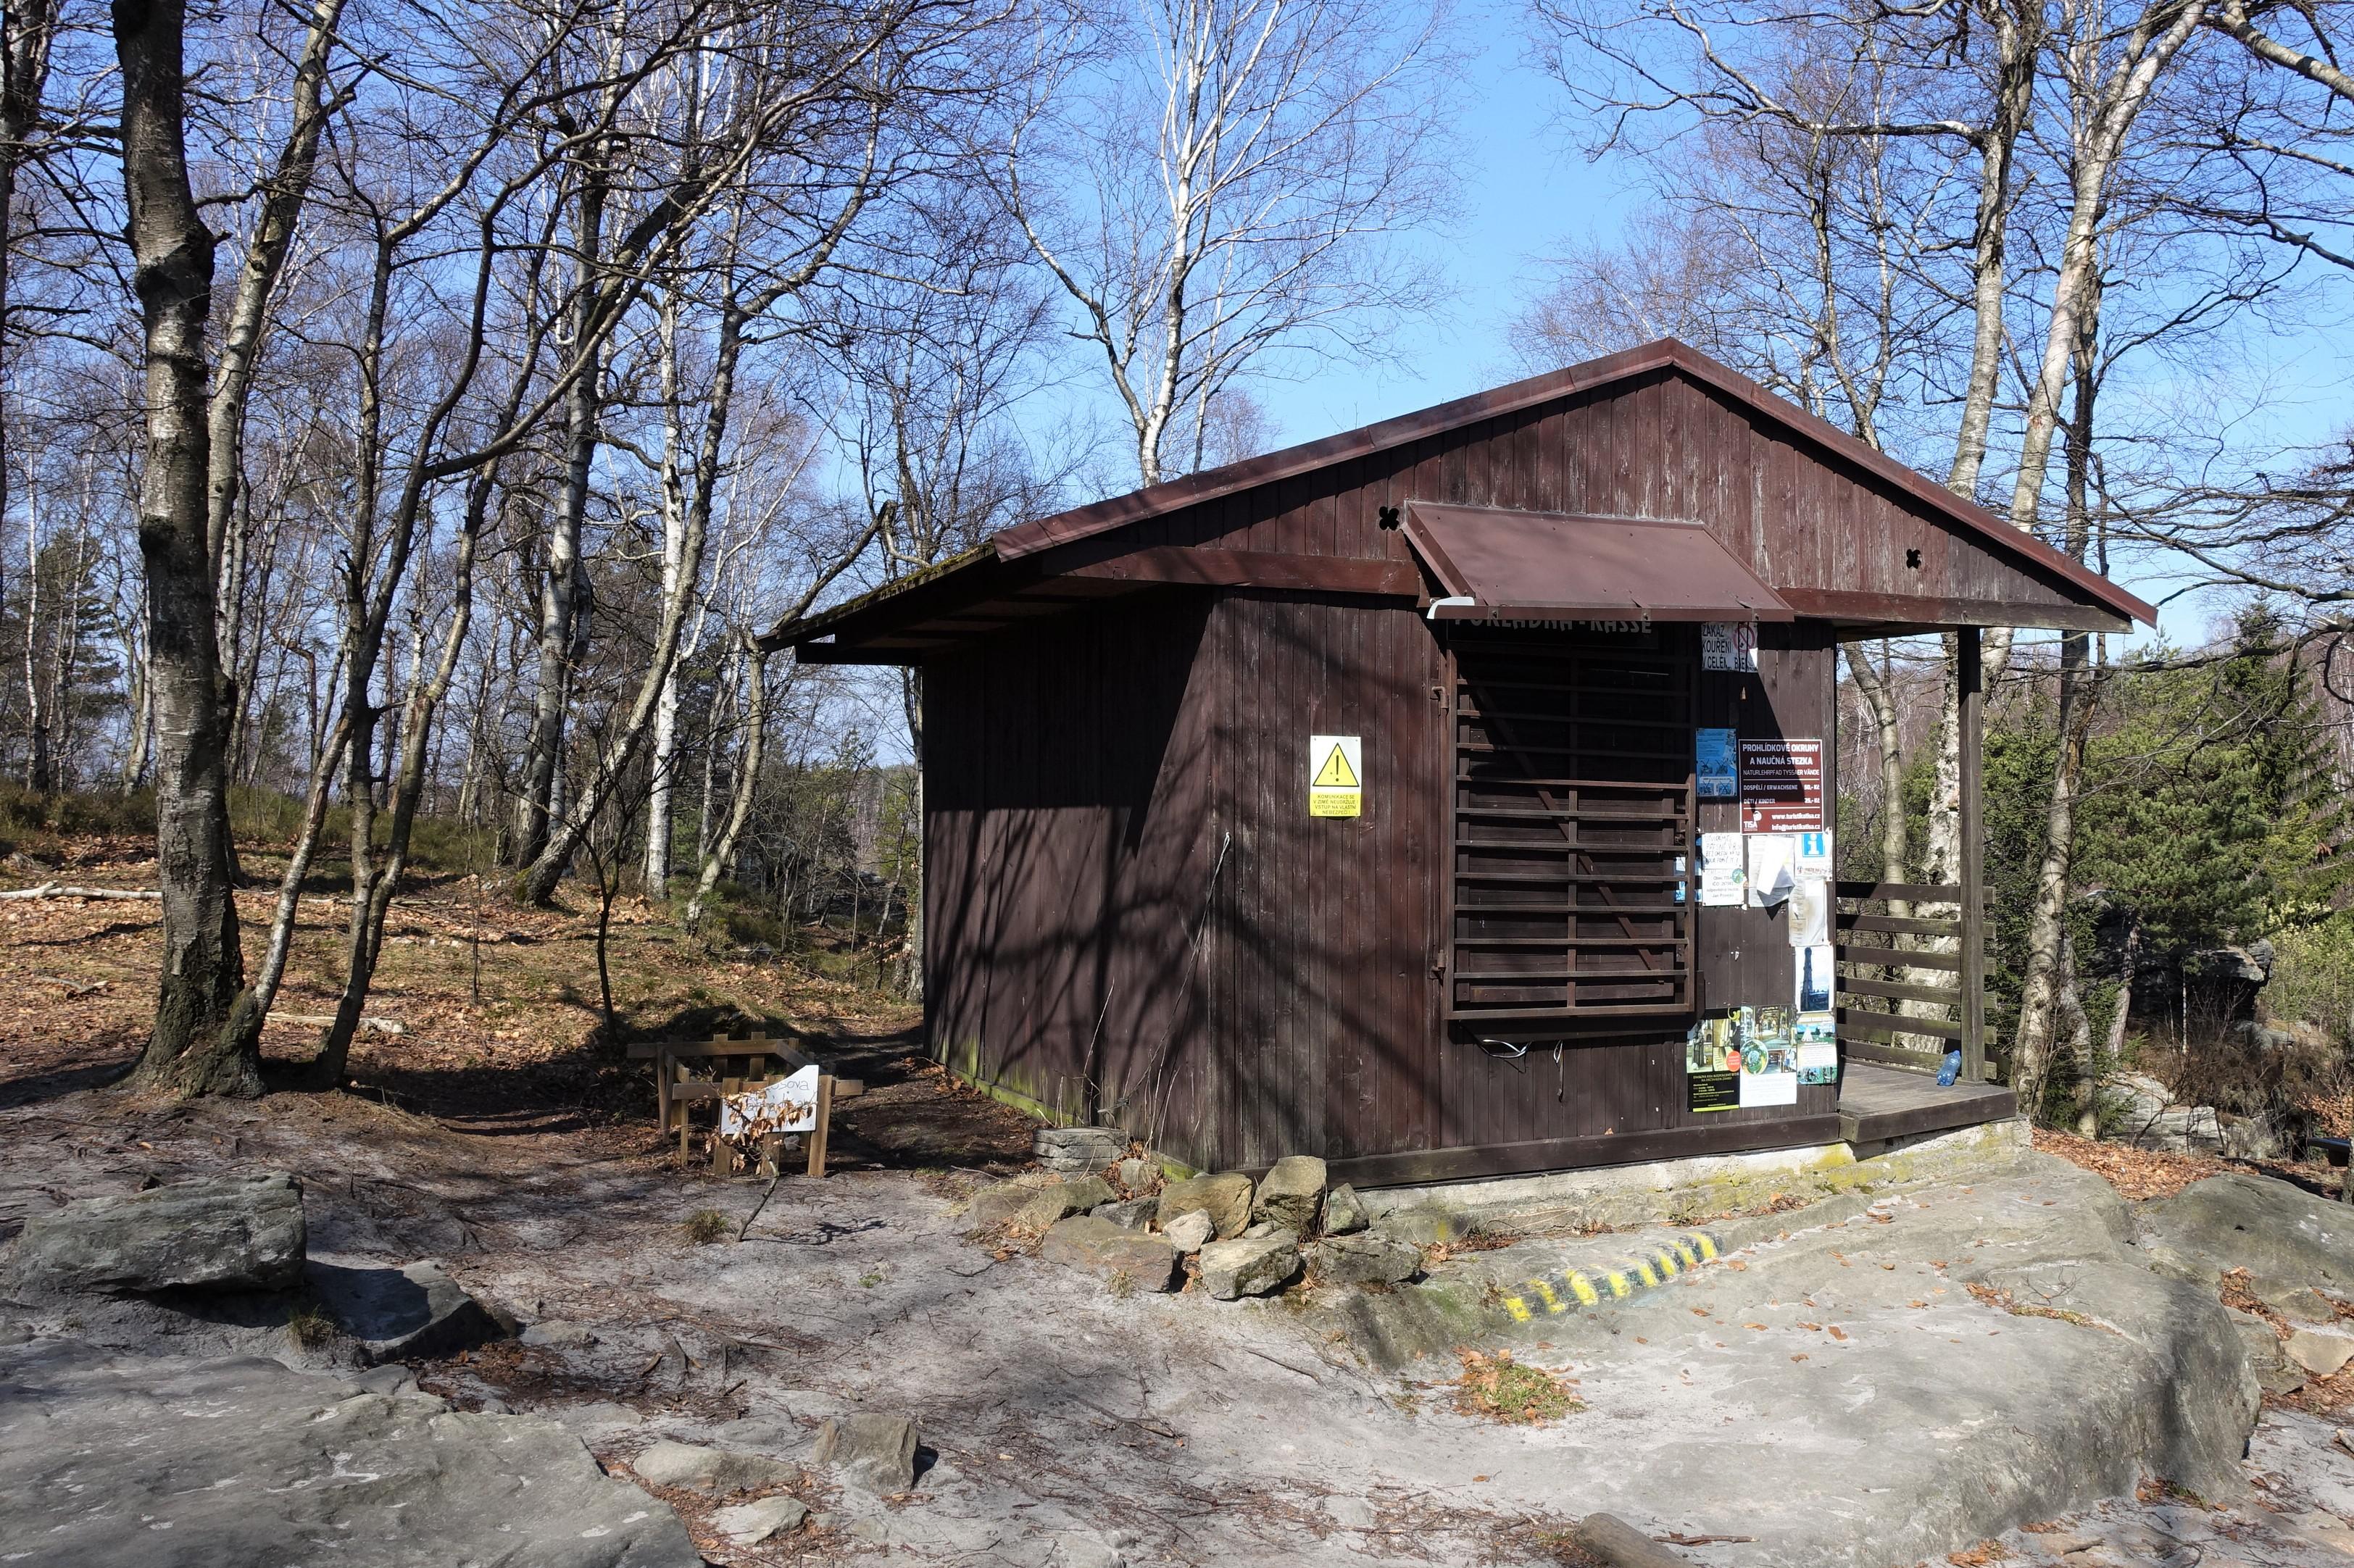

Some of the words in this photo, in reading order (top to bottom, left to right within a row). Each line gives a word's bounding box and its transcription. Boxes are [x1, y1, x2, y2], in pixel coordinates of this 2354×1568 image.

[1742, 742, 1790, 751] PROHLÍDKOVÉ
[1791, 743, 1819, 752] OKRUHY
[1756, 755, 1785, 764] NAUČNÁ
[1787, 756, 1813, 765] STEZKA
